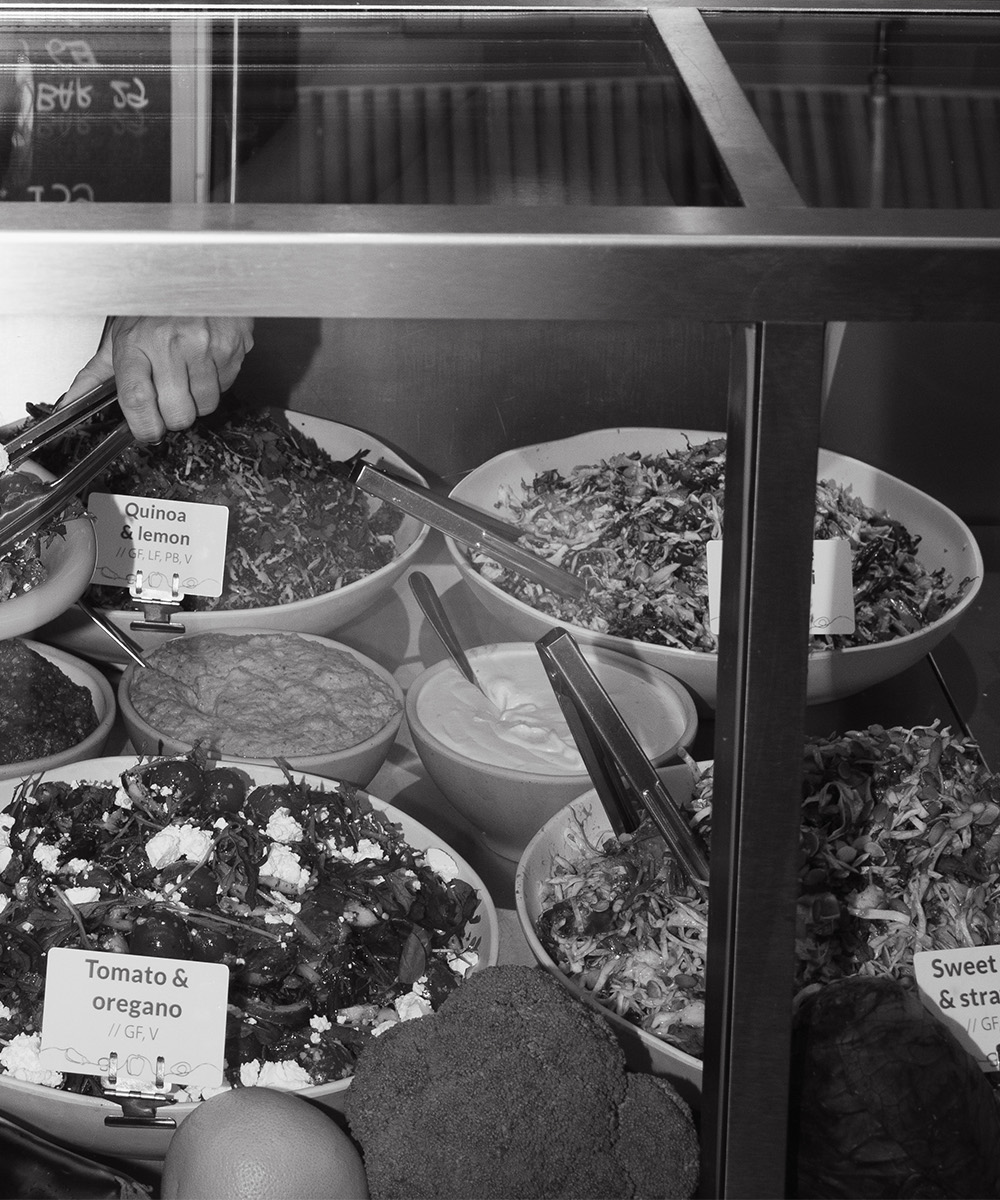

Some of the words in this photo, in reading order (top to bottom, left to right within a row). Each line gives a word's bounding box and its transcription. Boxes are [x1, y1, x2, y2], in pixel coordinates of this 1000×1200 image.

[125, 502, 187, 523] Quinoa
[120, 524, 133, 540] &
[138, 526, 190, 546] lemon
[185, 554, 193, 564] V
[85, 958, 167, 986] Tomato
[172, 968, 189, 988] &
[931, 955, 998, 979] Sweet
[92, 995, 182, 1019] oregano
[939, 989, 956, 1009] &
[960, 988, 1000, 1008] stra
[149, 1027, 159, 1041] V
[981, 1016, 1000, 1032] GF
